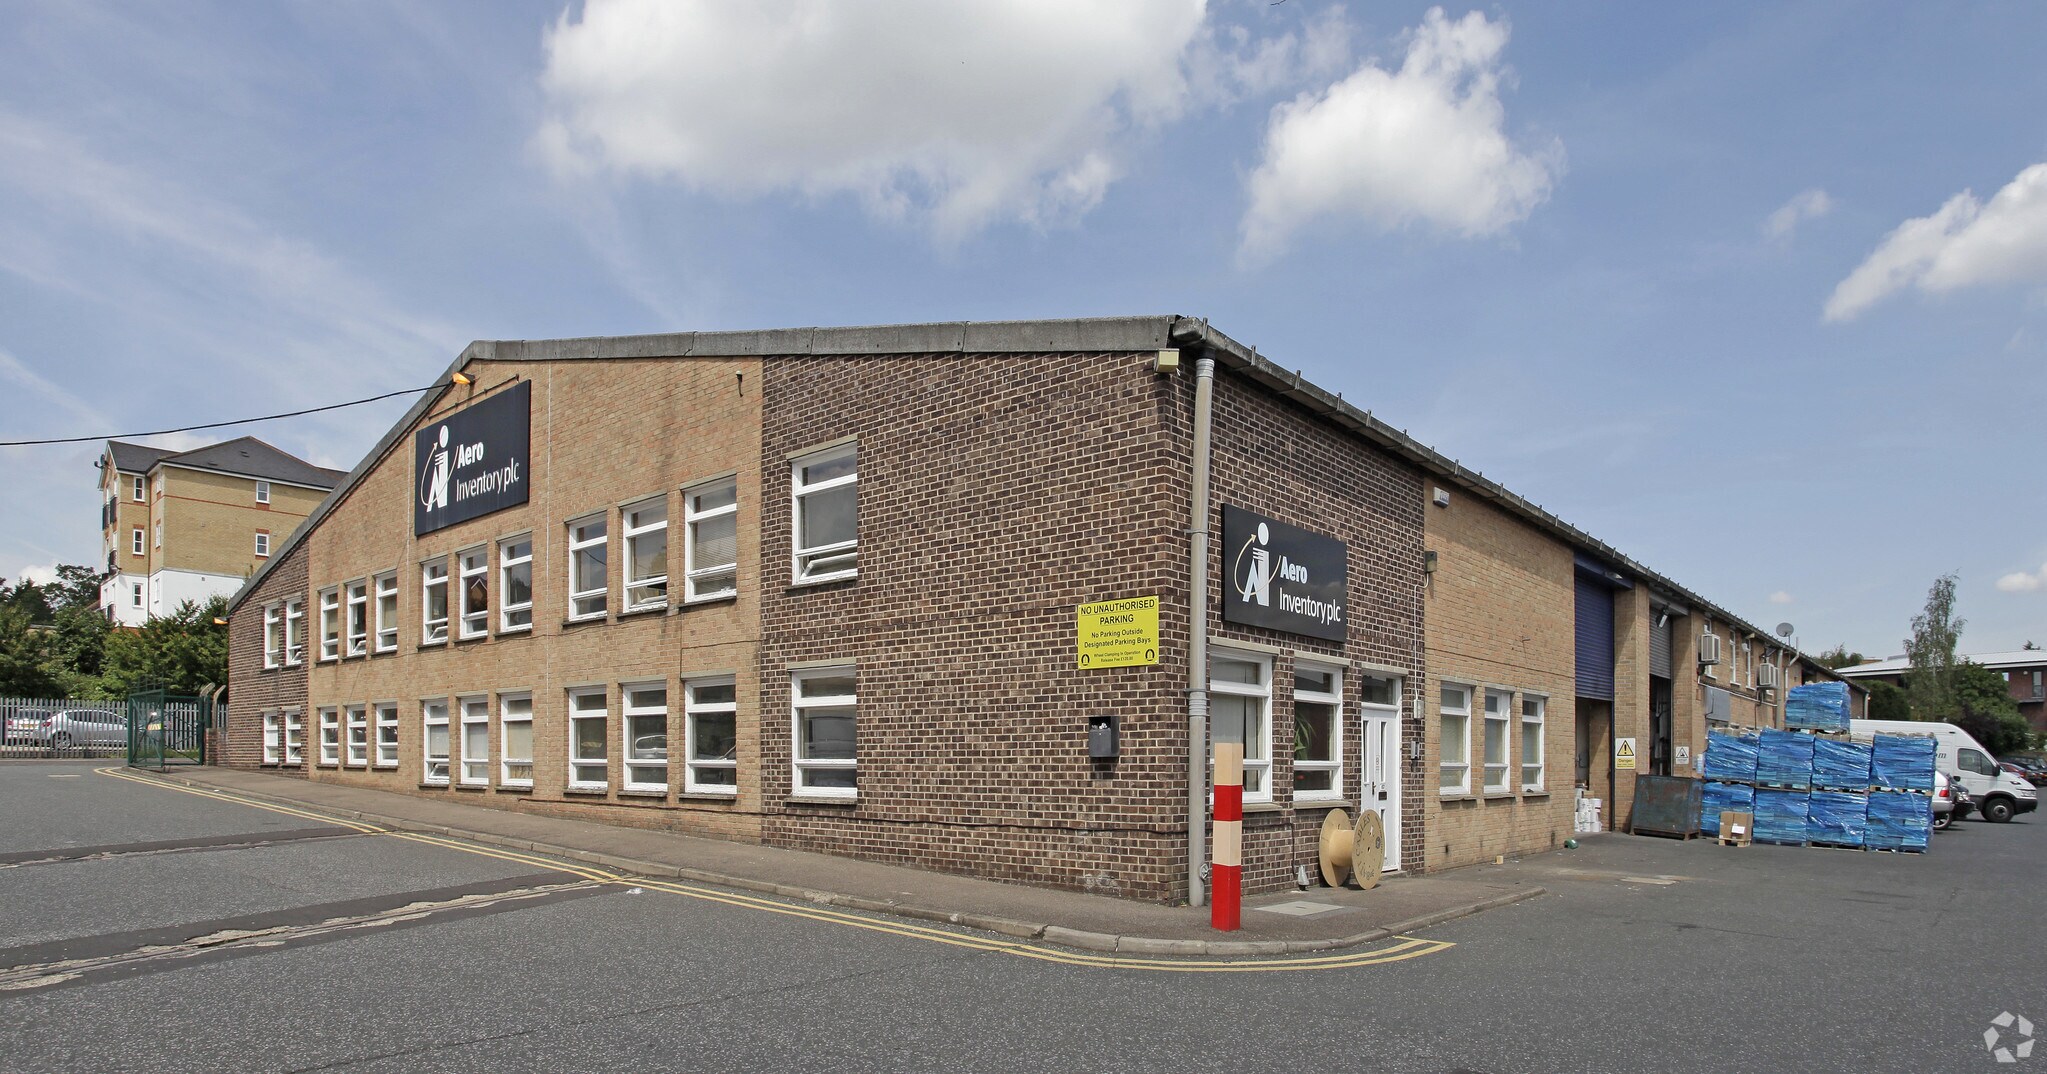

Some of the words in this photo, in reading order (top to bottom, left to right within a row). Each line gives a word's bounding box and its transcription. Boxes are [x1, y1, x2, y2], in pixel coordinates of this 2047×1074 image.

[457, 441, 484, 469] Aero
[456, 468, 503, 502] Inventory
[503, 457, 520, 492] plc
[1280, 555, 1308, 584] Aero
[1081, 606, 1092, 615] NO
[1093, 599, 1155, 614] UNAUTHORISED
[1279, 587, 1327, 624] Inventory
[1327, 599, 1341, 626] plc
[1100, 614, 1134, 625] PARKING
[1084, 640, 1114, 649] Designated
[1114, 638, 1136, 646] Parking
[1137, 637, 1151, 645] Bays
[1100, 630, 1120, 638] Parking
[1121, 628, 1144, 636] Outside
